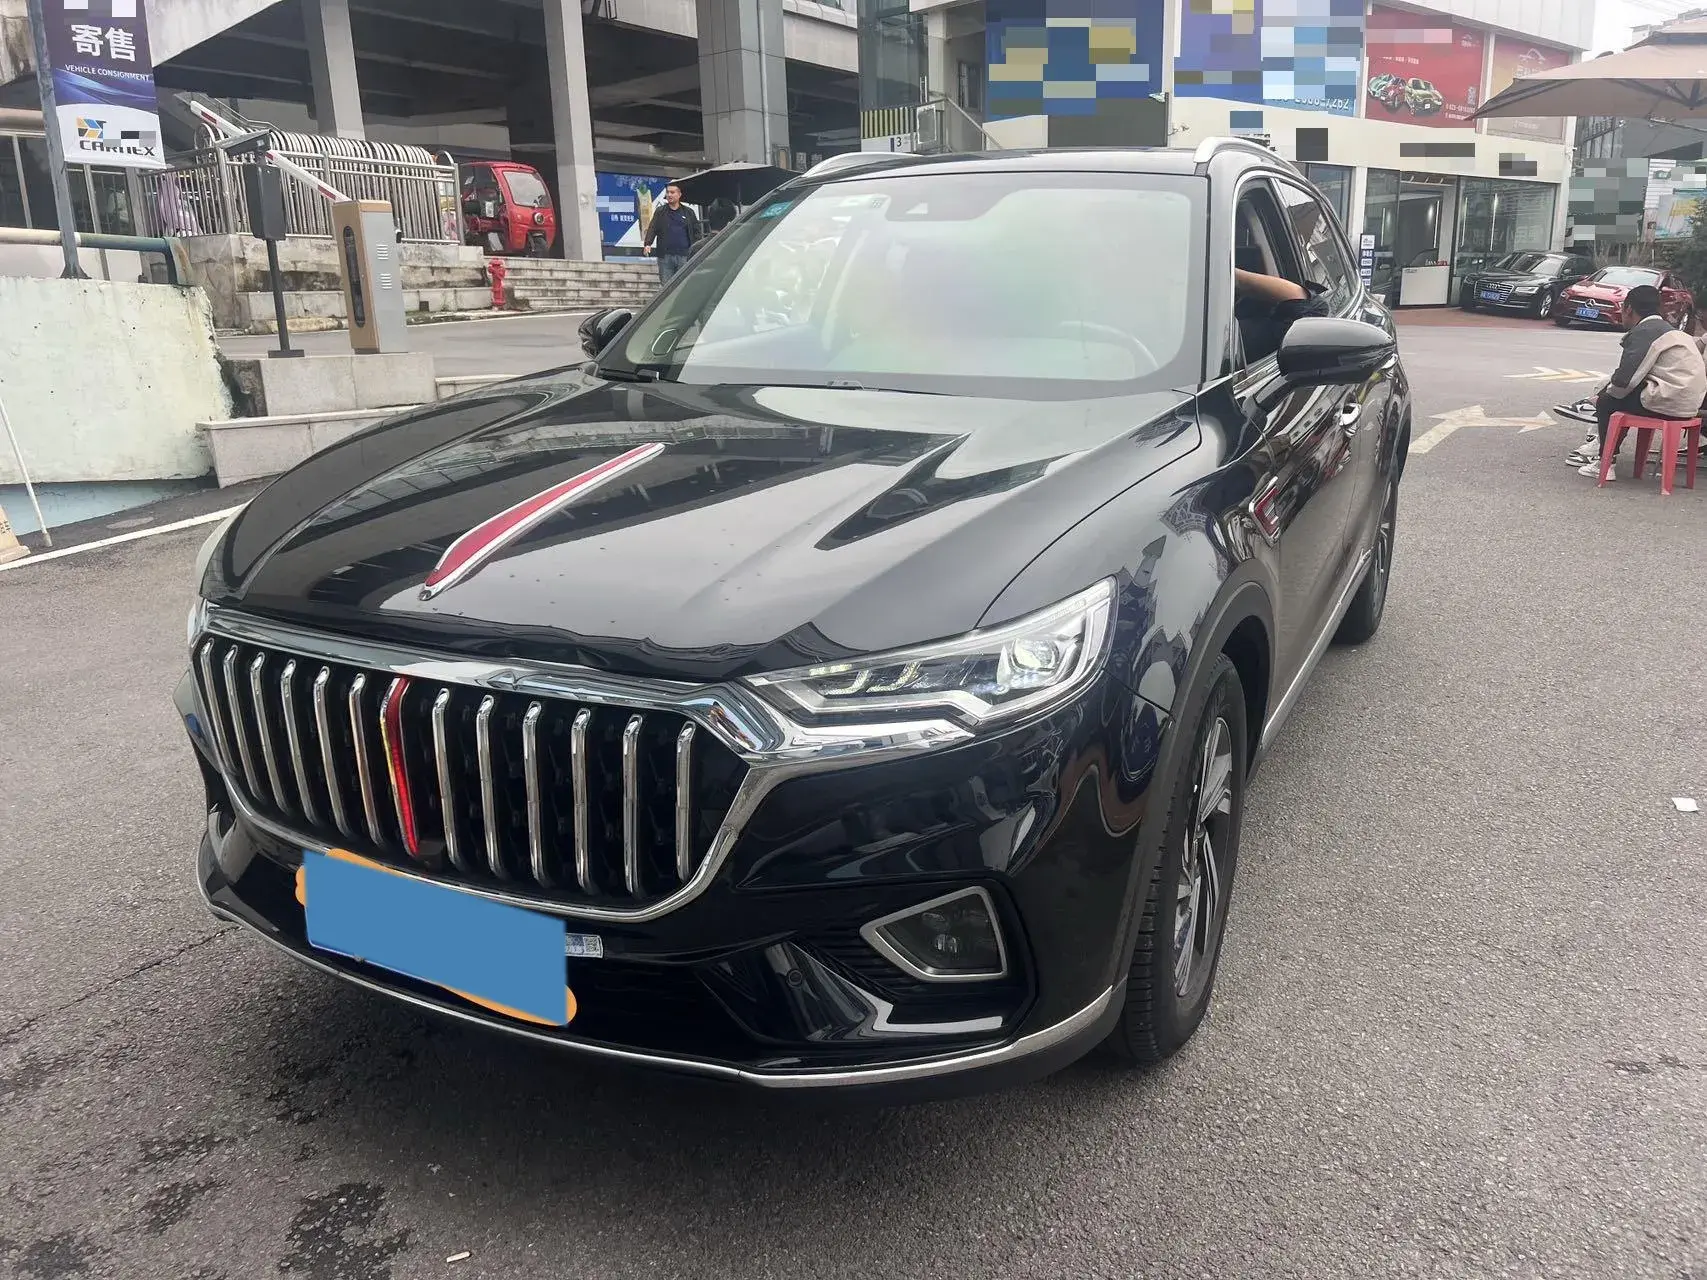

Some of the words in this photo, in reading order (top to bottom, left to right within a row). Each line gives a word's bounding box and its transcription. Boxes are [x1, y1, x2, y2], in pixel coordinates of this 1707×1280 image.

[71, 24, 136, 62] 寄售
[64, 63, 97, 74] VEHICLE
[97, 68, 150, 81] CONSIGNMENT
